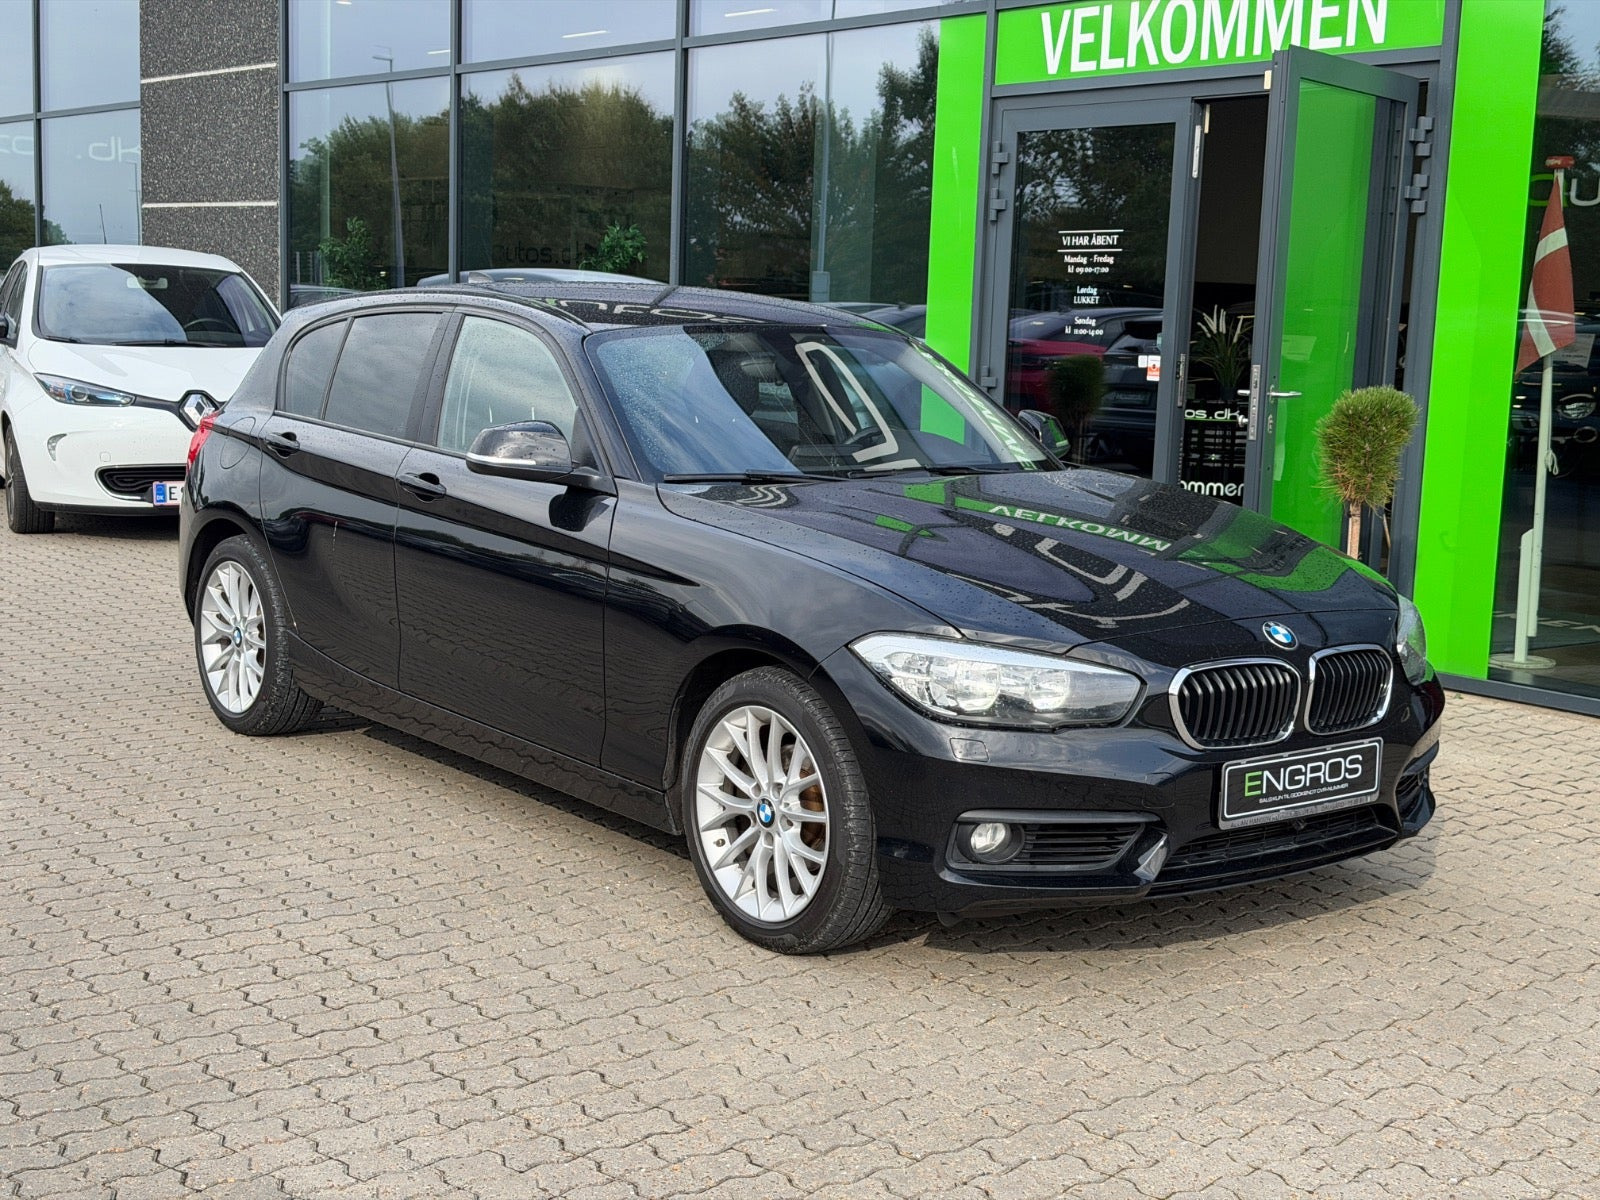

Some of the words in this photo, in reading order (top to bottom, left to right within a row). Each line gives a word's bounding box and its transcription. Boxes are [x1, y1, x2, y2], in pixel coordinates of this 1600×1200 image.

[1041, 0, 1387, 75] VELKOMMEN
[1062, 236, 1071, 246] VI
[1072, 235, 1089, 246] HAR
[1090, 233, 1119, 246] ÅBENT
[1064, 254, 1088, 264] Mandag
[1093, 254, 1114, 264] Fredag
[1074, 296, 1100, 304] LUKKET
[1244, 754, 1363, 797] ENGROS
